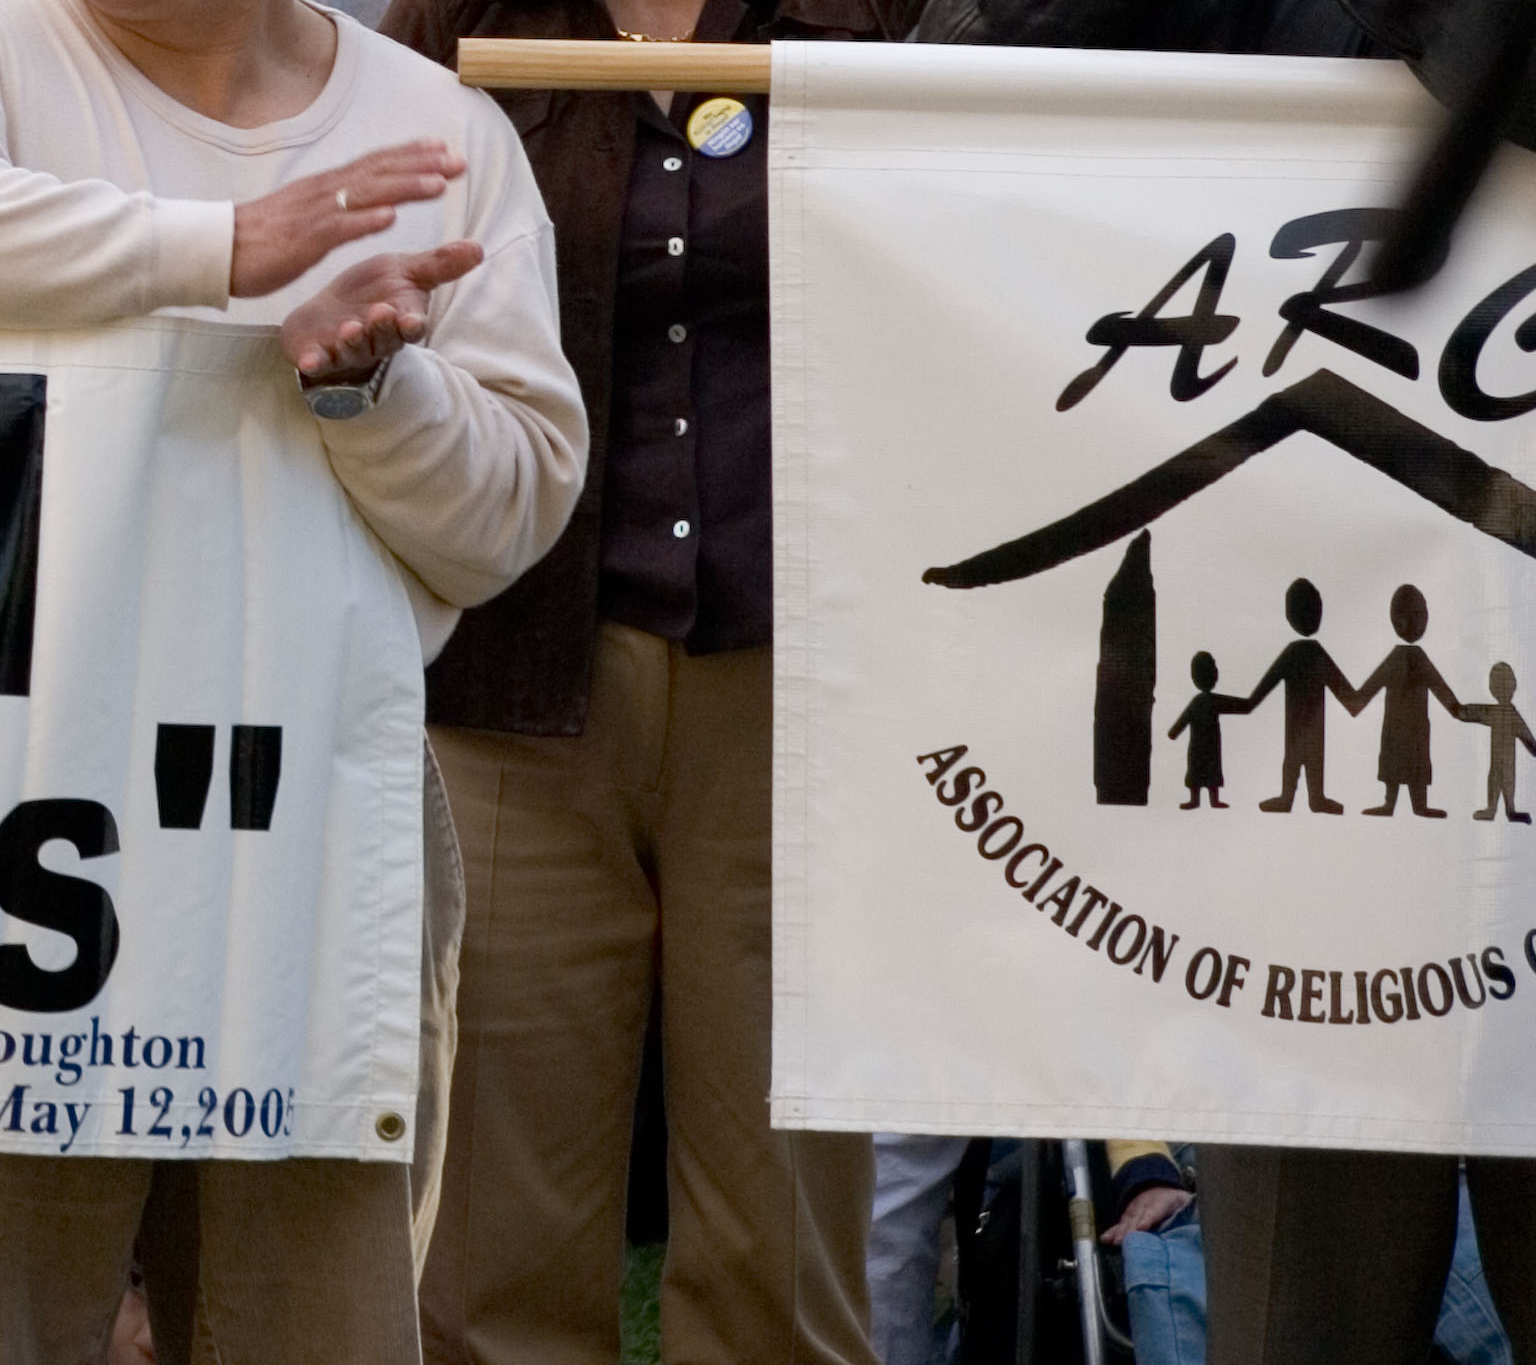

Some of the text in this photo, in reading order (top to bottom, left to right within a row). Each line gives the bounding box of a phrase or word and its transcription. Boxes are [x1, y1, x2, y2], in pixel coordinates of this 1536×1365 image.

[917, 745, 1179, 982] ASSOCIATION
[1186, 948, 1250, 1007] OF
[1262, 947, 1515, 1024] RELIGIOUS
